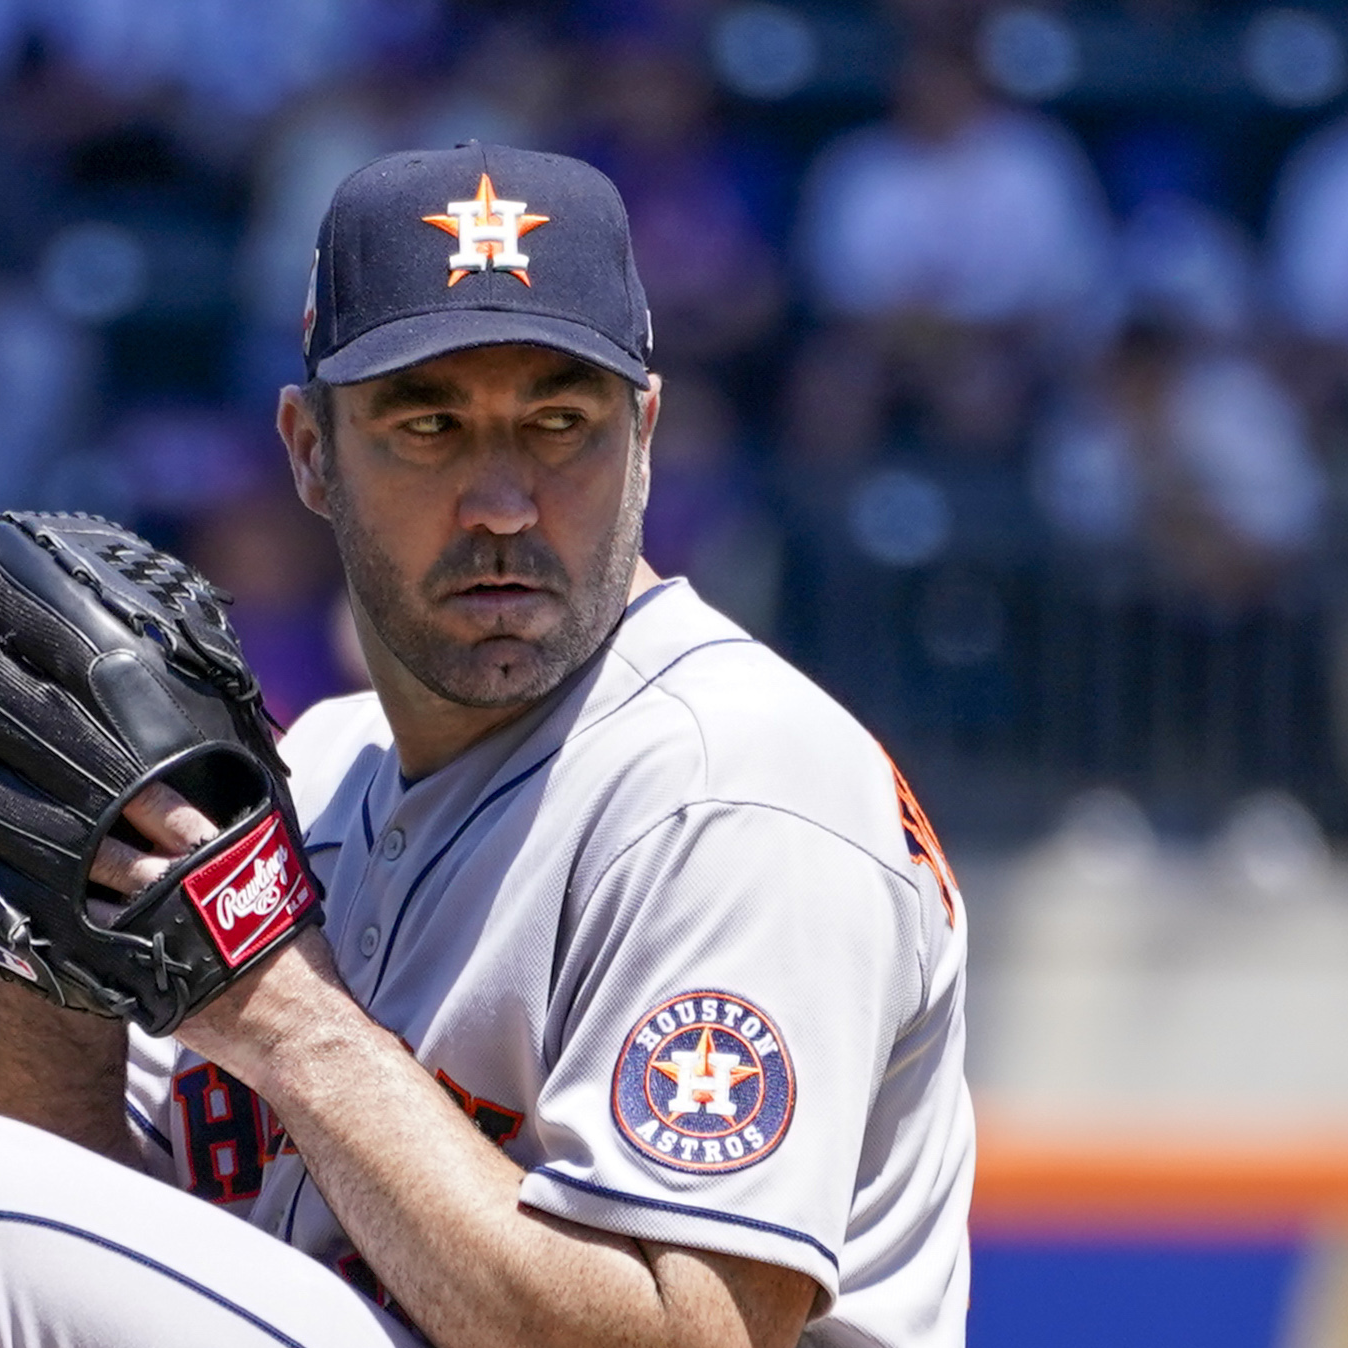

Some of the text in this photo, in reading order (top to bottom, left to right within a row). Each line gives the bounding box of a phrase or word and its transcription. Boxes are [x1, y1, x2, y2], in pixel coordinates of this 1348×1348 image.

[447, 199, 530, 272] H
[215, 844, 289, 931] Rawlings
[634, 998, 780, 1057] HOUSTON
[667, 1050, 741, 1116] H
[635, 1119, 765, 1163] ASTROS
